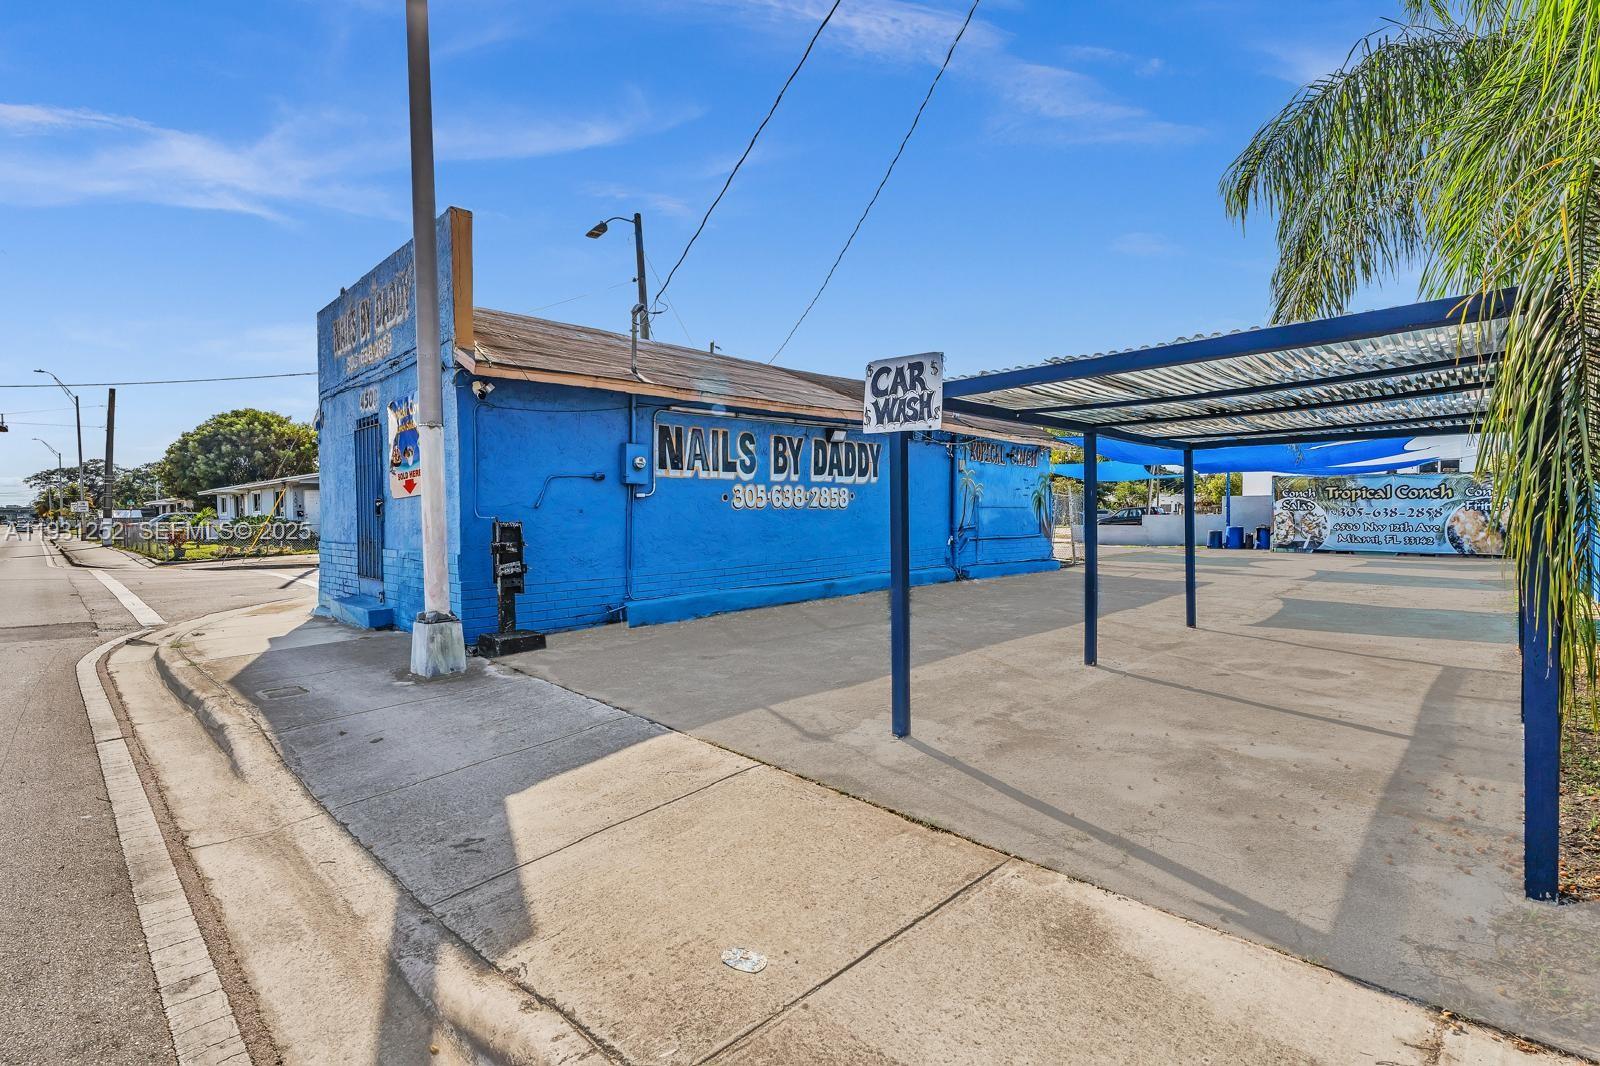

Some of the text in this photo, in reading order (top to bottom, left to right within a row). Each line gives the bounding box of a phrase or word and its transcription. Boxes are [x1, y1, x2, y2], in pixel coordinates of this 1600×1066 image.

[359, 298, 371, 343] BY
[870, 361, 928, 397] CAR
[870, 391, 935, 424] WASH
[655, 423, 882, 485] NAILS BY DADDY
[397, 472, 408, 480] SOLD
[1282, 488, 1316, 498] Conch
[1325, 483, 1454, 502] Tropical Conch
[1465, 487, 1502, 497] Con
[1282, 500, 1315, 511] Salad
[1340, 507, 1443, 518] 305-638-2858
[1333, 523, 1361, 532] 4500
[1389, 521, 1414, 532] 12th
[1415, 522, 1441, 532] Ave
[1337, 534, 1435, 546] Miami, FL 33142
